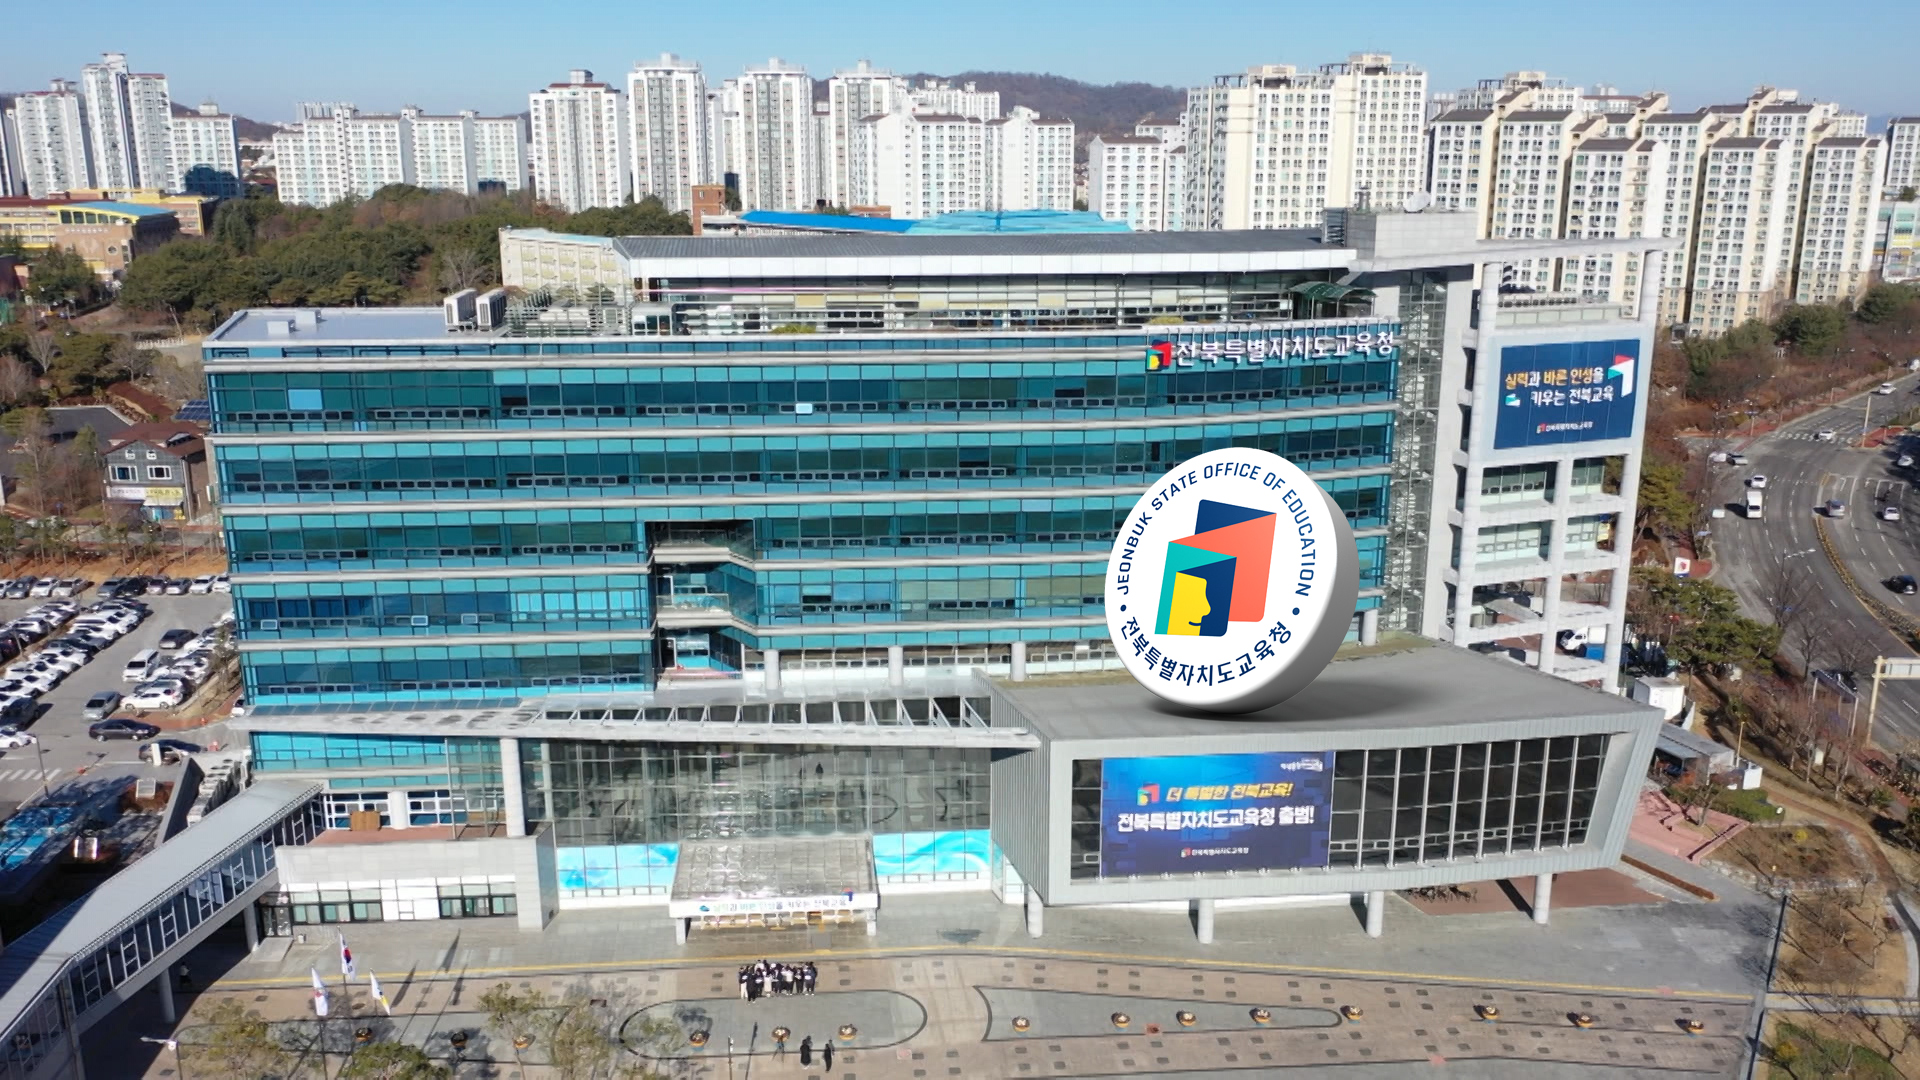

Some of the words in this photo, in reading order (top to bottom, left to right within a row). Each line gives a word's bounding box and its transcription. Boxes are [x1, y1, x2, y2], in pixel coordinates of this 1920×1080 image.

[1177, 331, 1394, 368] 전북특별자치도교육청
[1505, 371, 1541, 390] 실력과
[1543, 368, 1568, 386] 바른
[1570, 366, 1604, 385] 인성을
[1530, 389, 1566, 407] 키우는
[1569, 385, 1614, 404] 전북교육
[1166, 787, 1183, 802] 더
[1230, 783, 1294, 799] 전북교육!
[1118, 807, 1275, 832] 전북특별자치도교육청
[1279, 805, 1315, 826] 출범!
